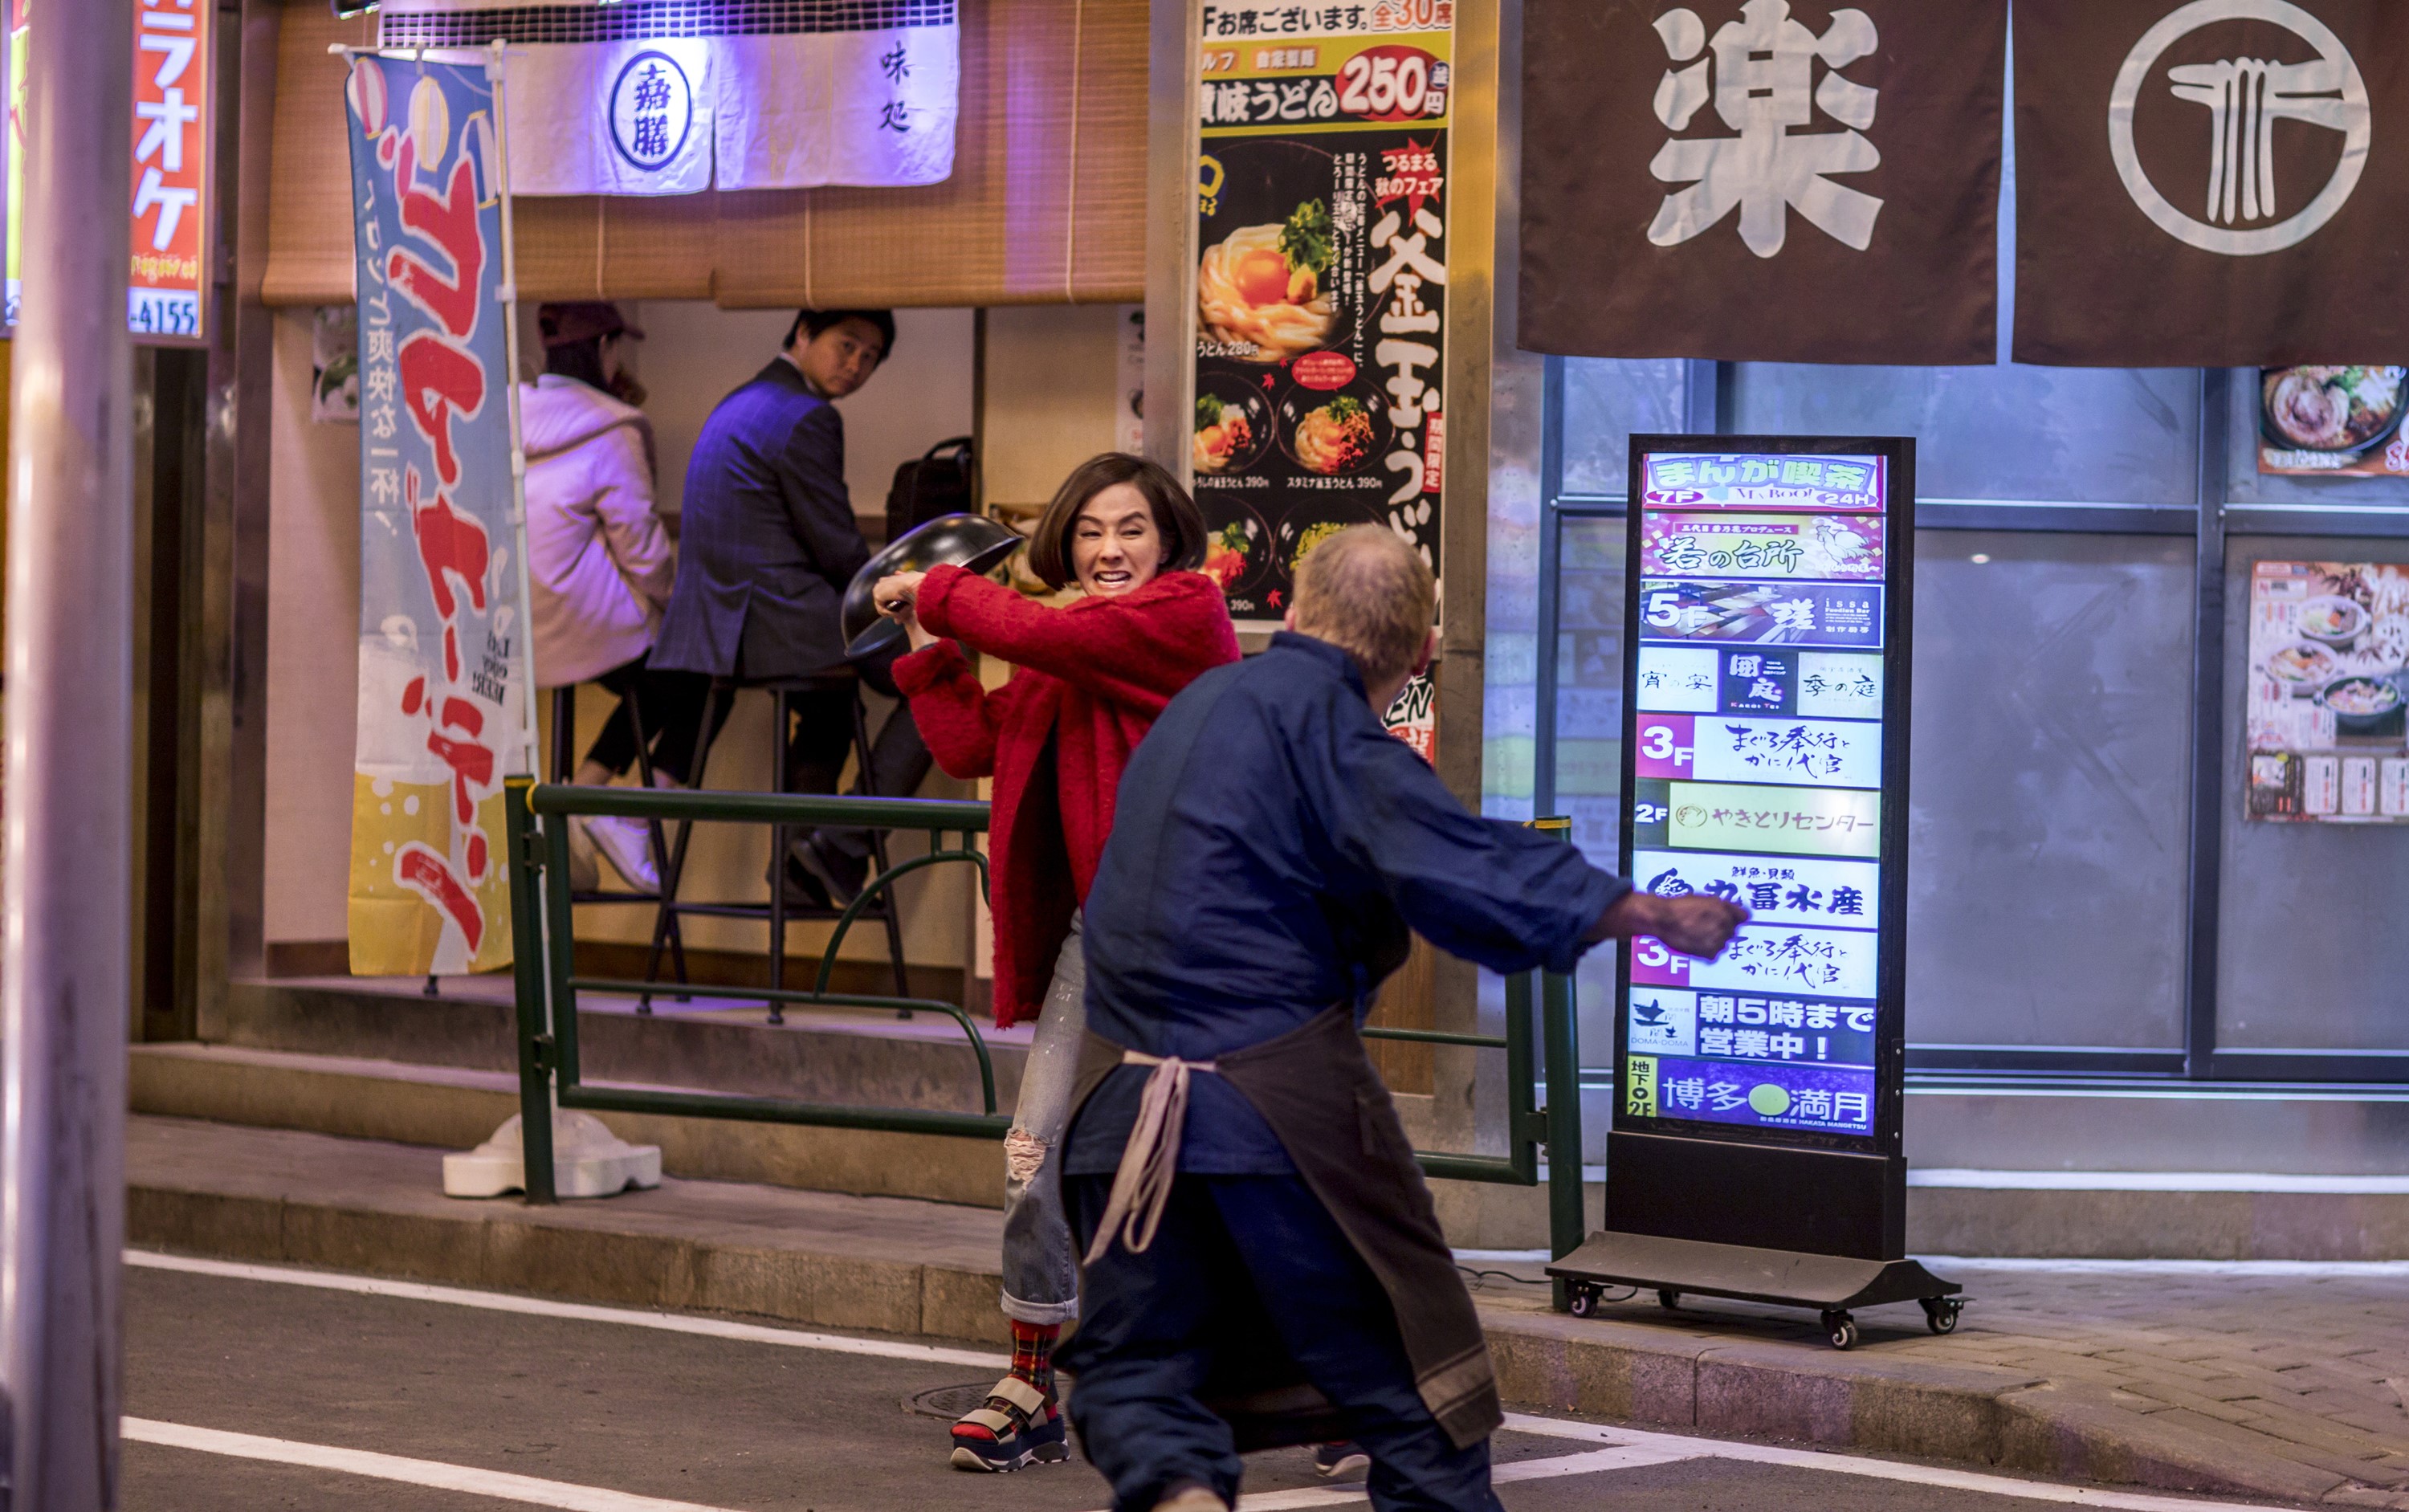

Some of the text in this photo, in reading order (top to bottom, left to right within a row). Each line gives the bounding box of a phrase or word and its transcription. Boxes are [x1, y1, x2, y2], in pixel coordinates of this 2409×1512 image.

[132, 0, 198, 251] ラオケ
[1647, 0, 1885, 259] 楽
[1382, 152, 1438, 172] つるまる
[1656, 460, 1867, 491] まんが喫茶
[1655, 491, 1694, 503] 7F
[1824, 492, 1869, 505] 24H
[1647, 593, 1708, 628] 5F
[1804, 674, 1877, 698] 季の庭
[1642, 726, 1694, 766] 3F
[1635, 805, 1668, 824] 2F
[1712, 808, 1873, 832] やきとりセンター
[1637, 938, 1689, 974] 3F
[1699, 996, 1875, 1033] 朝5時まで
[1699, 1027, 1828, 1060] 営業中!
[1631, 1060, 1650, 1086] 地下
[1662, 1077, 1868, 1123] 博多 満月
